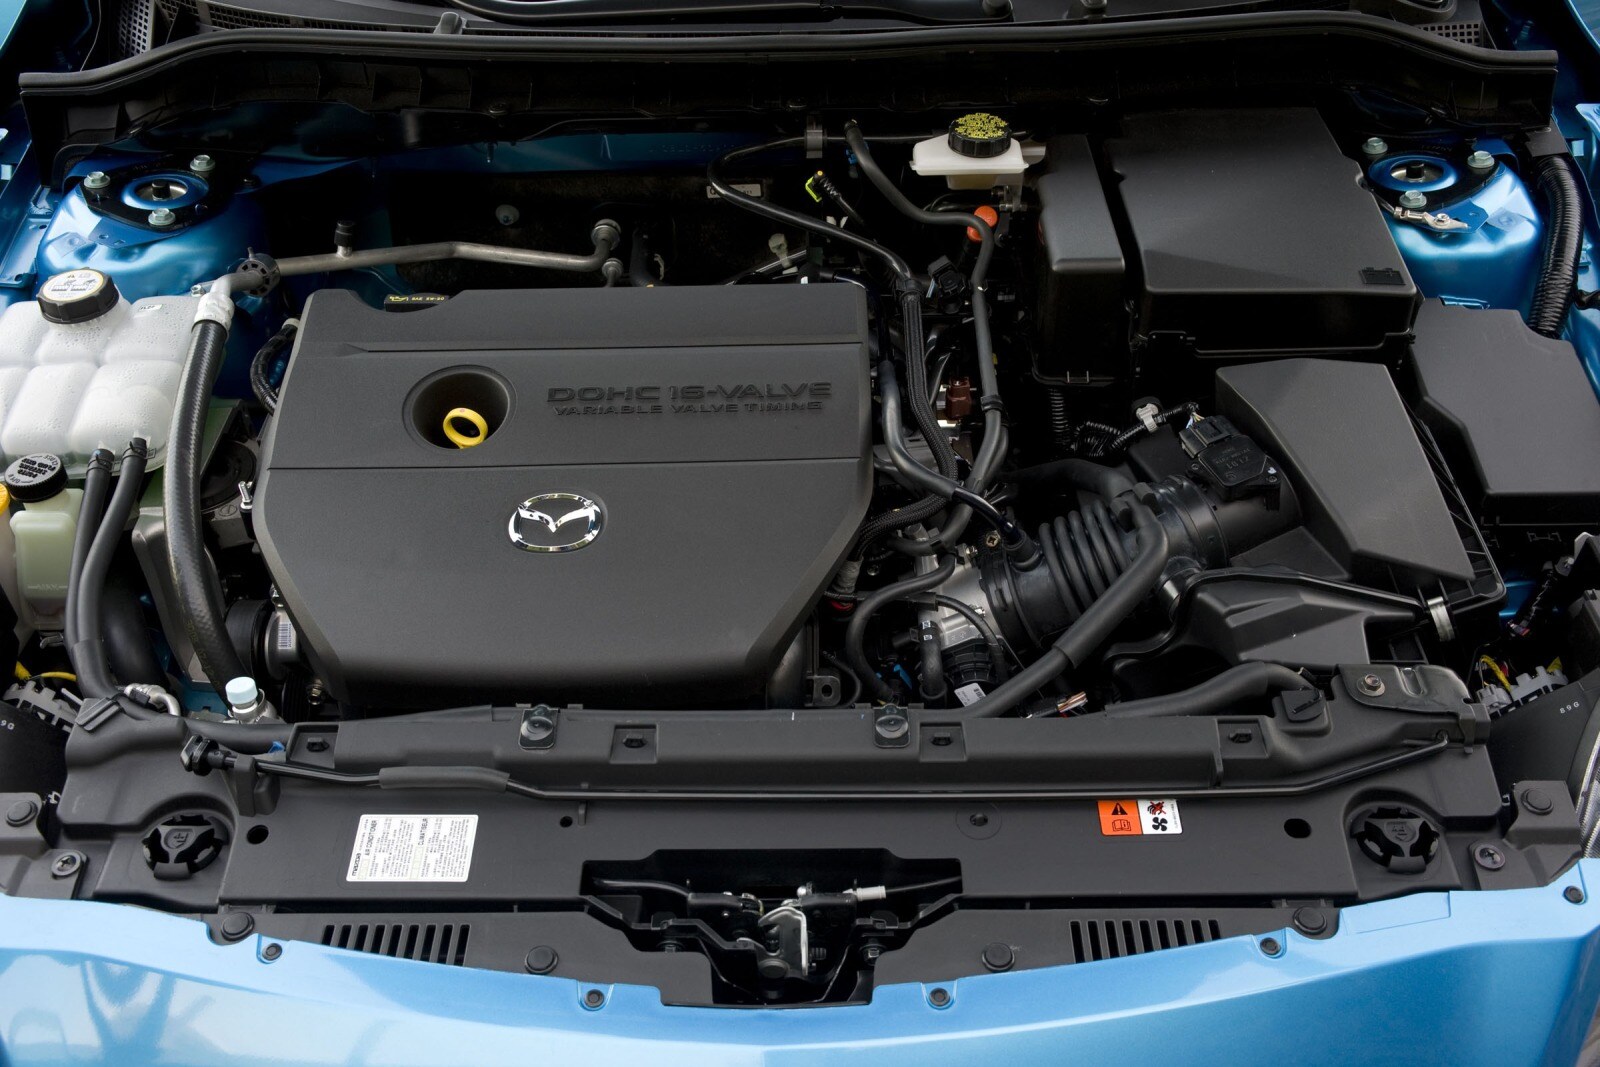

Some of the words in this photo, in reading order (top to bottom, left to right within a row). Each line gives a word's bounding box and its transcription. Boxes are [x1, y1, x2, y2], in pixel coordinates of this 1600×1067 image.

[547, 386, 661, 402] DOHC
[670, 381, 832, 400] 16-VALVE
[553, 405, 663, 416] VARIABLE
[670, 403, 739, 414] VALVE
[744, 401, 823, 412] TIMING
